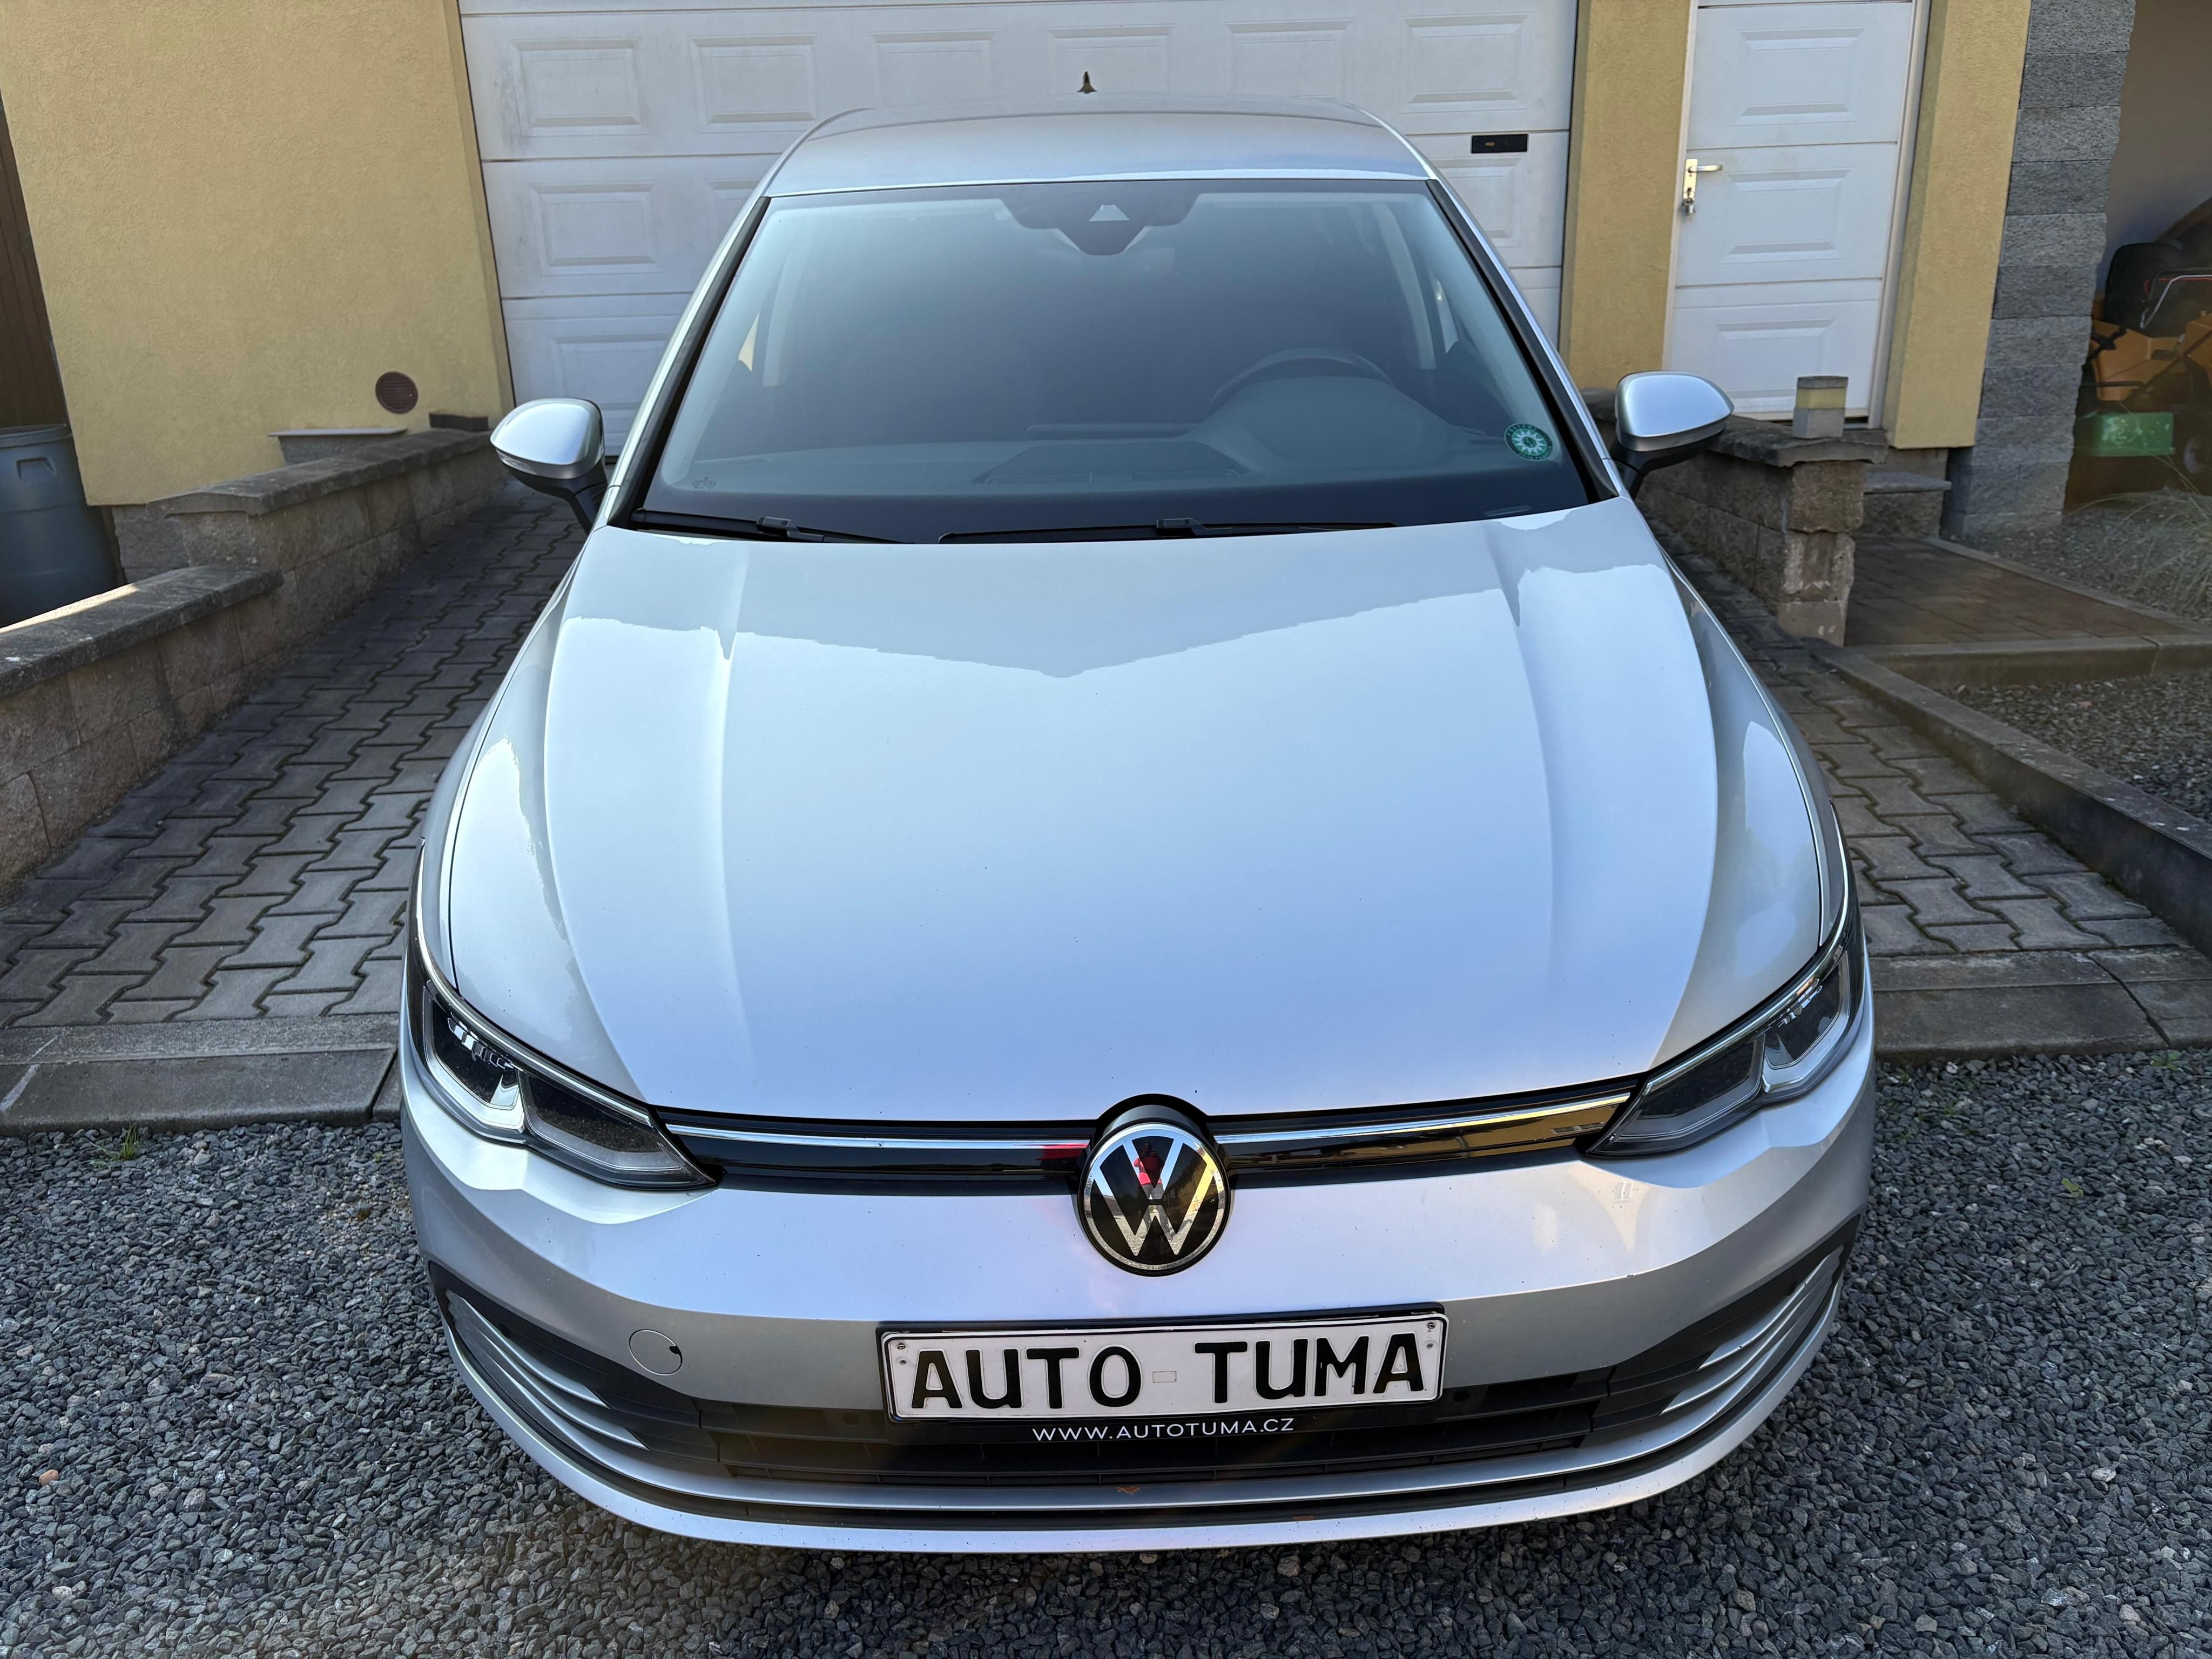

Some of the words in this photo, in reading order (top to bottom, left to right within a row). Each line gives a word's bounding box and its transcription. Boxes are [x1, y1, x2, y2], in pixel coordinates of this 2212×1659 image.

[911, 1346, 1142, 1410] AUTO
[1194, 1333, 1424, 1404] TUMA
[1031, 1418, 1294, 1441] WWW.AUTOTUMA.CZ
